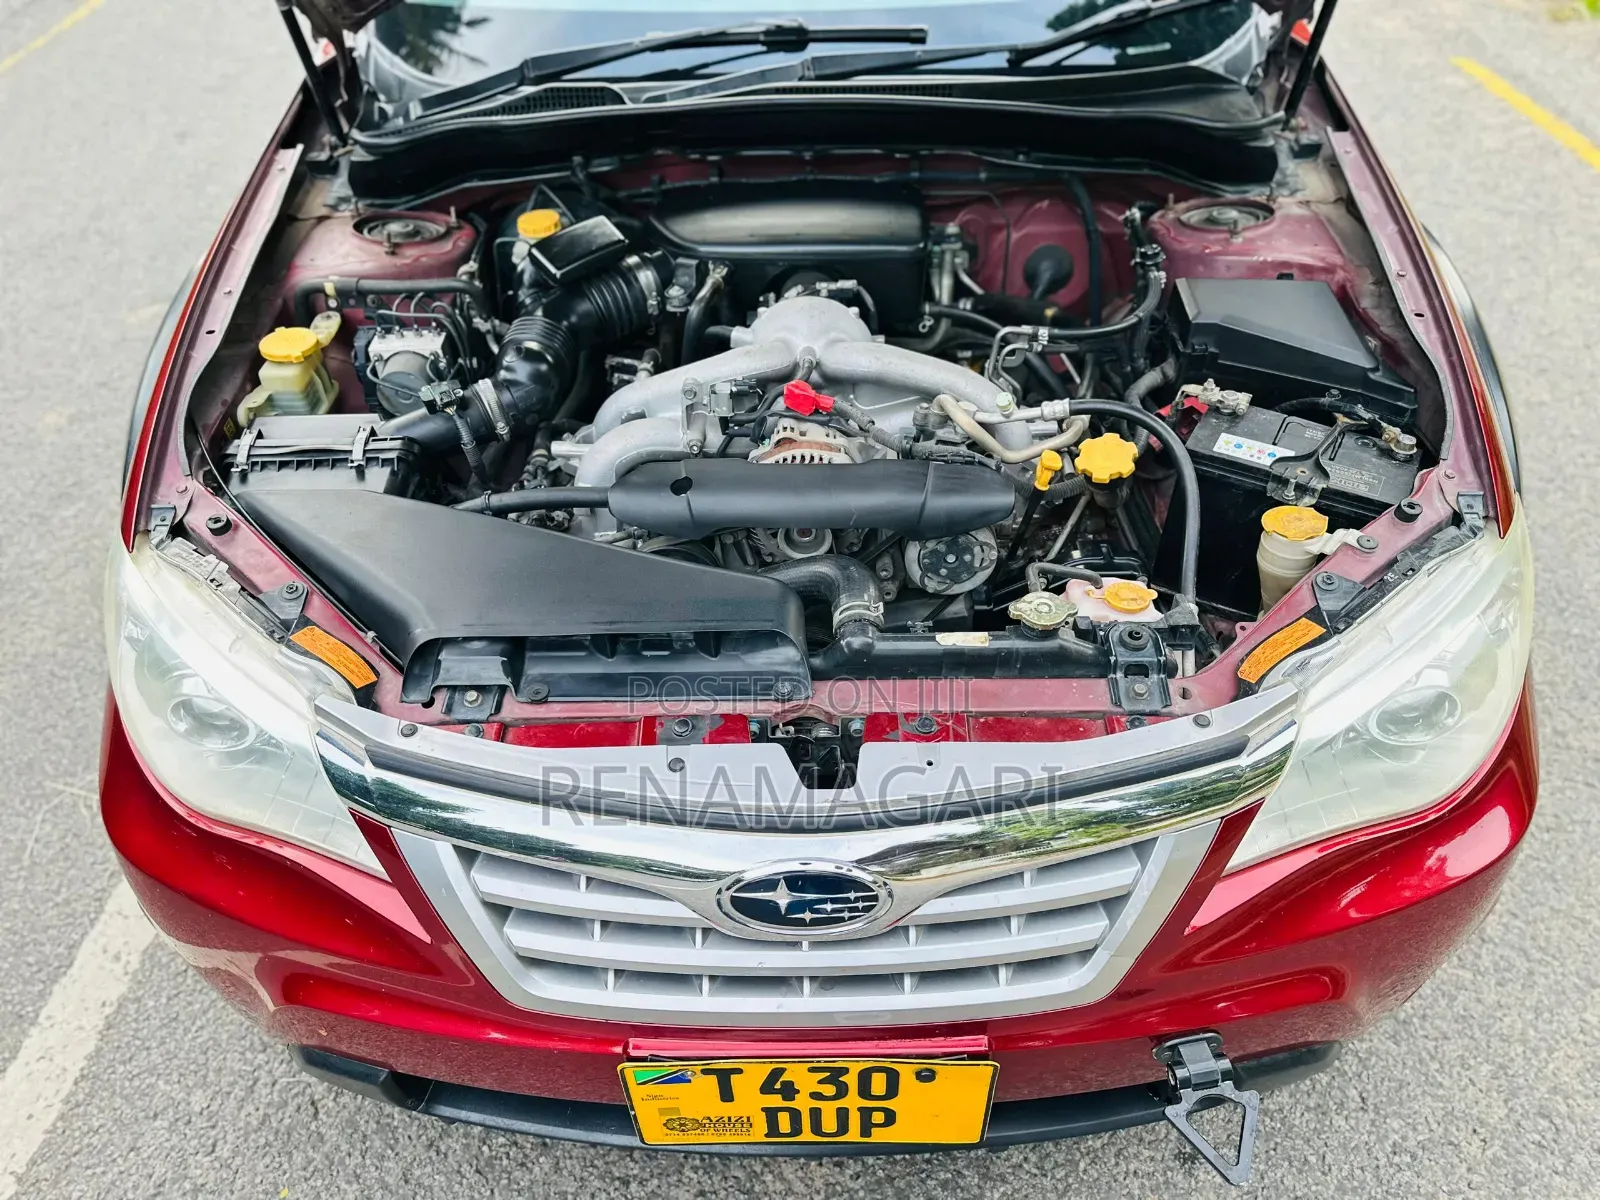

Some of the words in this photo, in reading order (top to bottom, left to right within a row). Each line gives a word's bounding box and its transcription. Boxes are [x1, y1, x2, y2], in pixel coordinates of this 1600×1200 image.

[700, 1067, 744, 1103] T
[759, 1065, 901, 1102] 430
[700, 1115, 751, 1123] AZIZI
[760, 1106, 899, 1139] DUP
